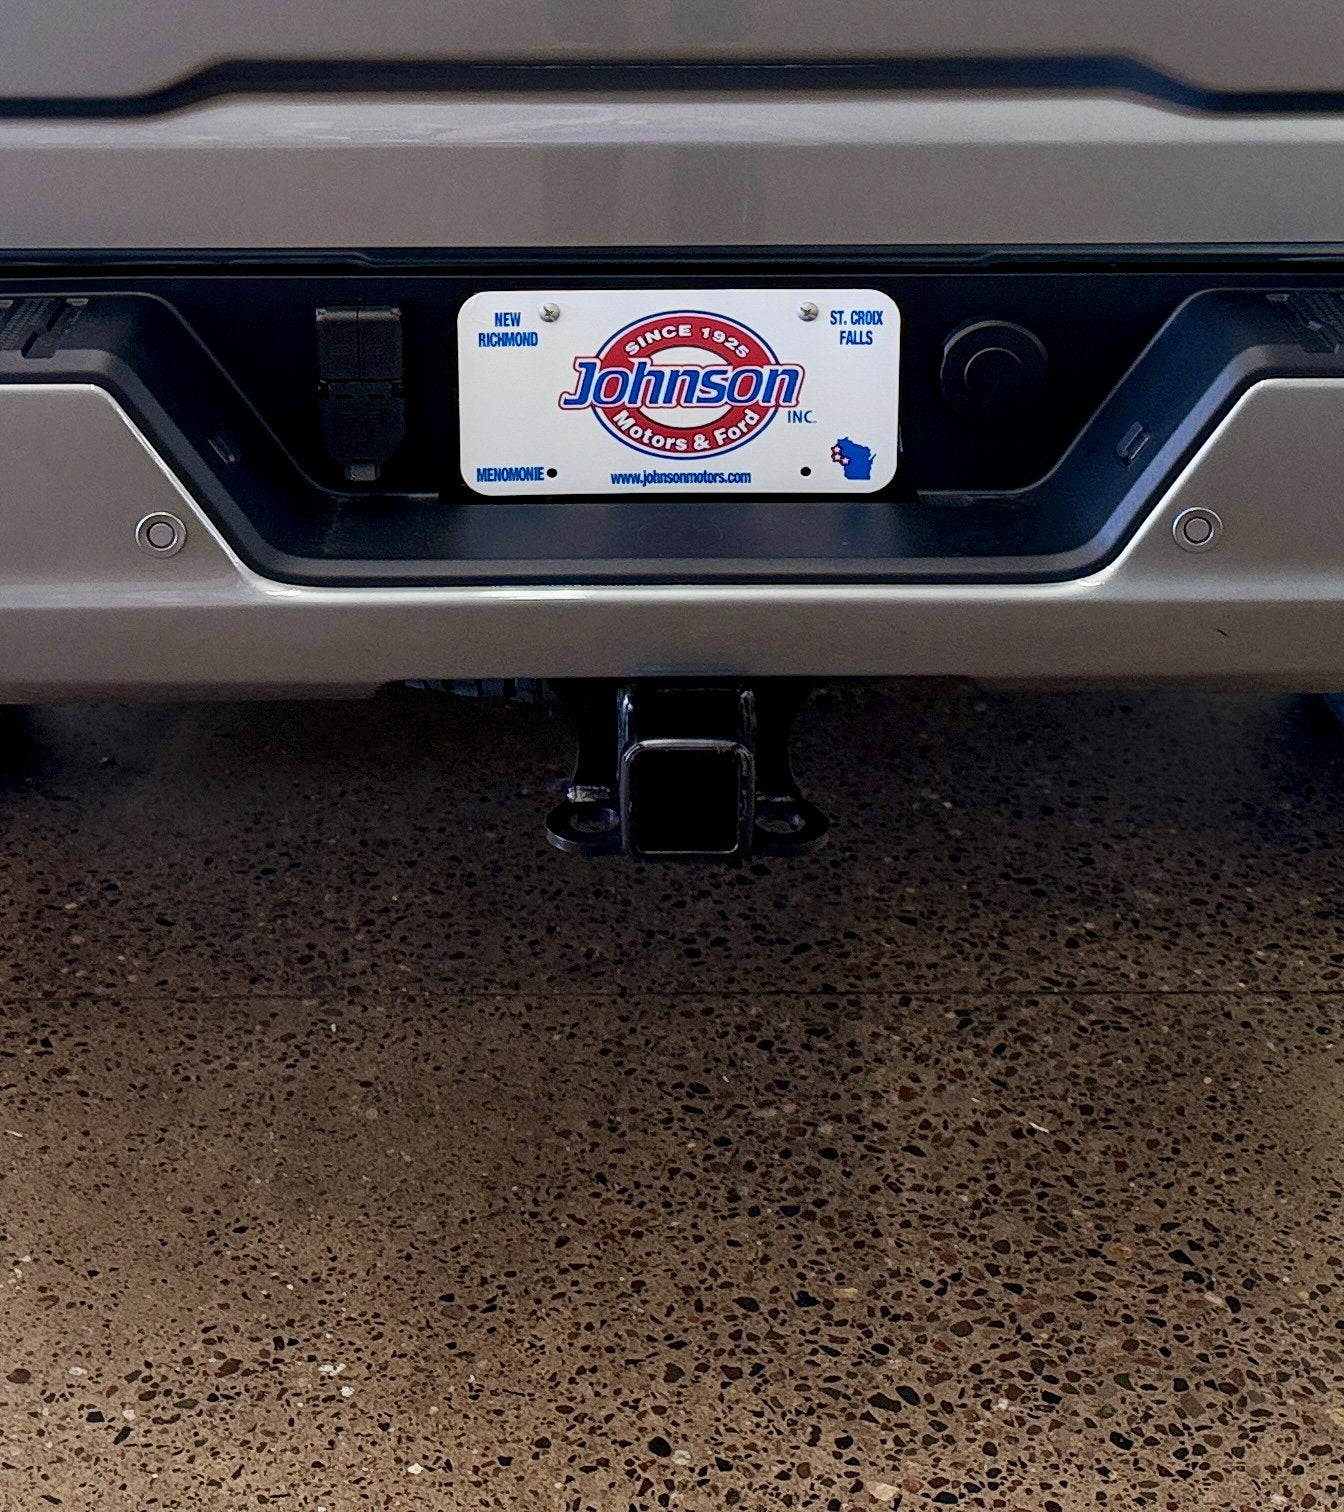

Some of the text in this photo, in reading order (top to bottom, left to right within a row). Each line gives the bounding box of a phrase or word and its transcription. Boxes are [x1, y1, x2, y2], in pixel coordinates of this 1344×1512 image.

[494, 312, 521, 328] NEW
[830, 310, 884, 327] ST. CROIX
[478, 332, 538, 348] RICHMOND
[625, 324, 750, 359] SINCE 1925
[840, 330, 873, 346] FALLS
[562, 361, 802, 408] Johnson
[613, 409, 760, 452] Motors & Ford
[476, 467, 544, 482] MENOMONIE
[610, 470, 752, 487] www.johnsonmotors.com
